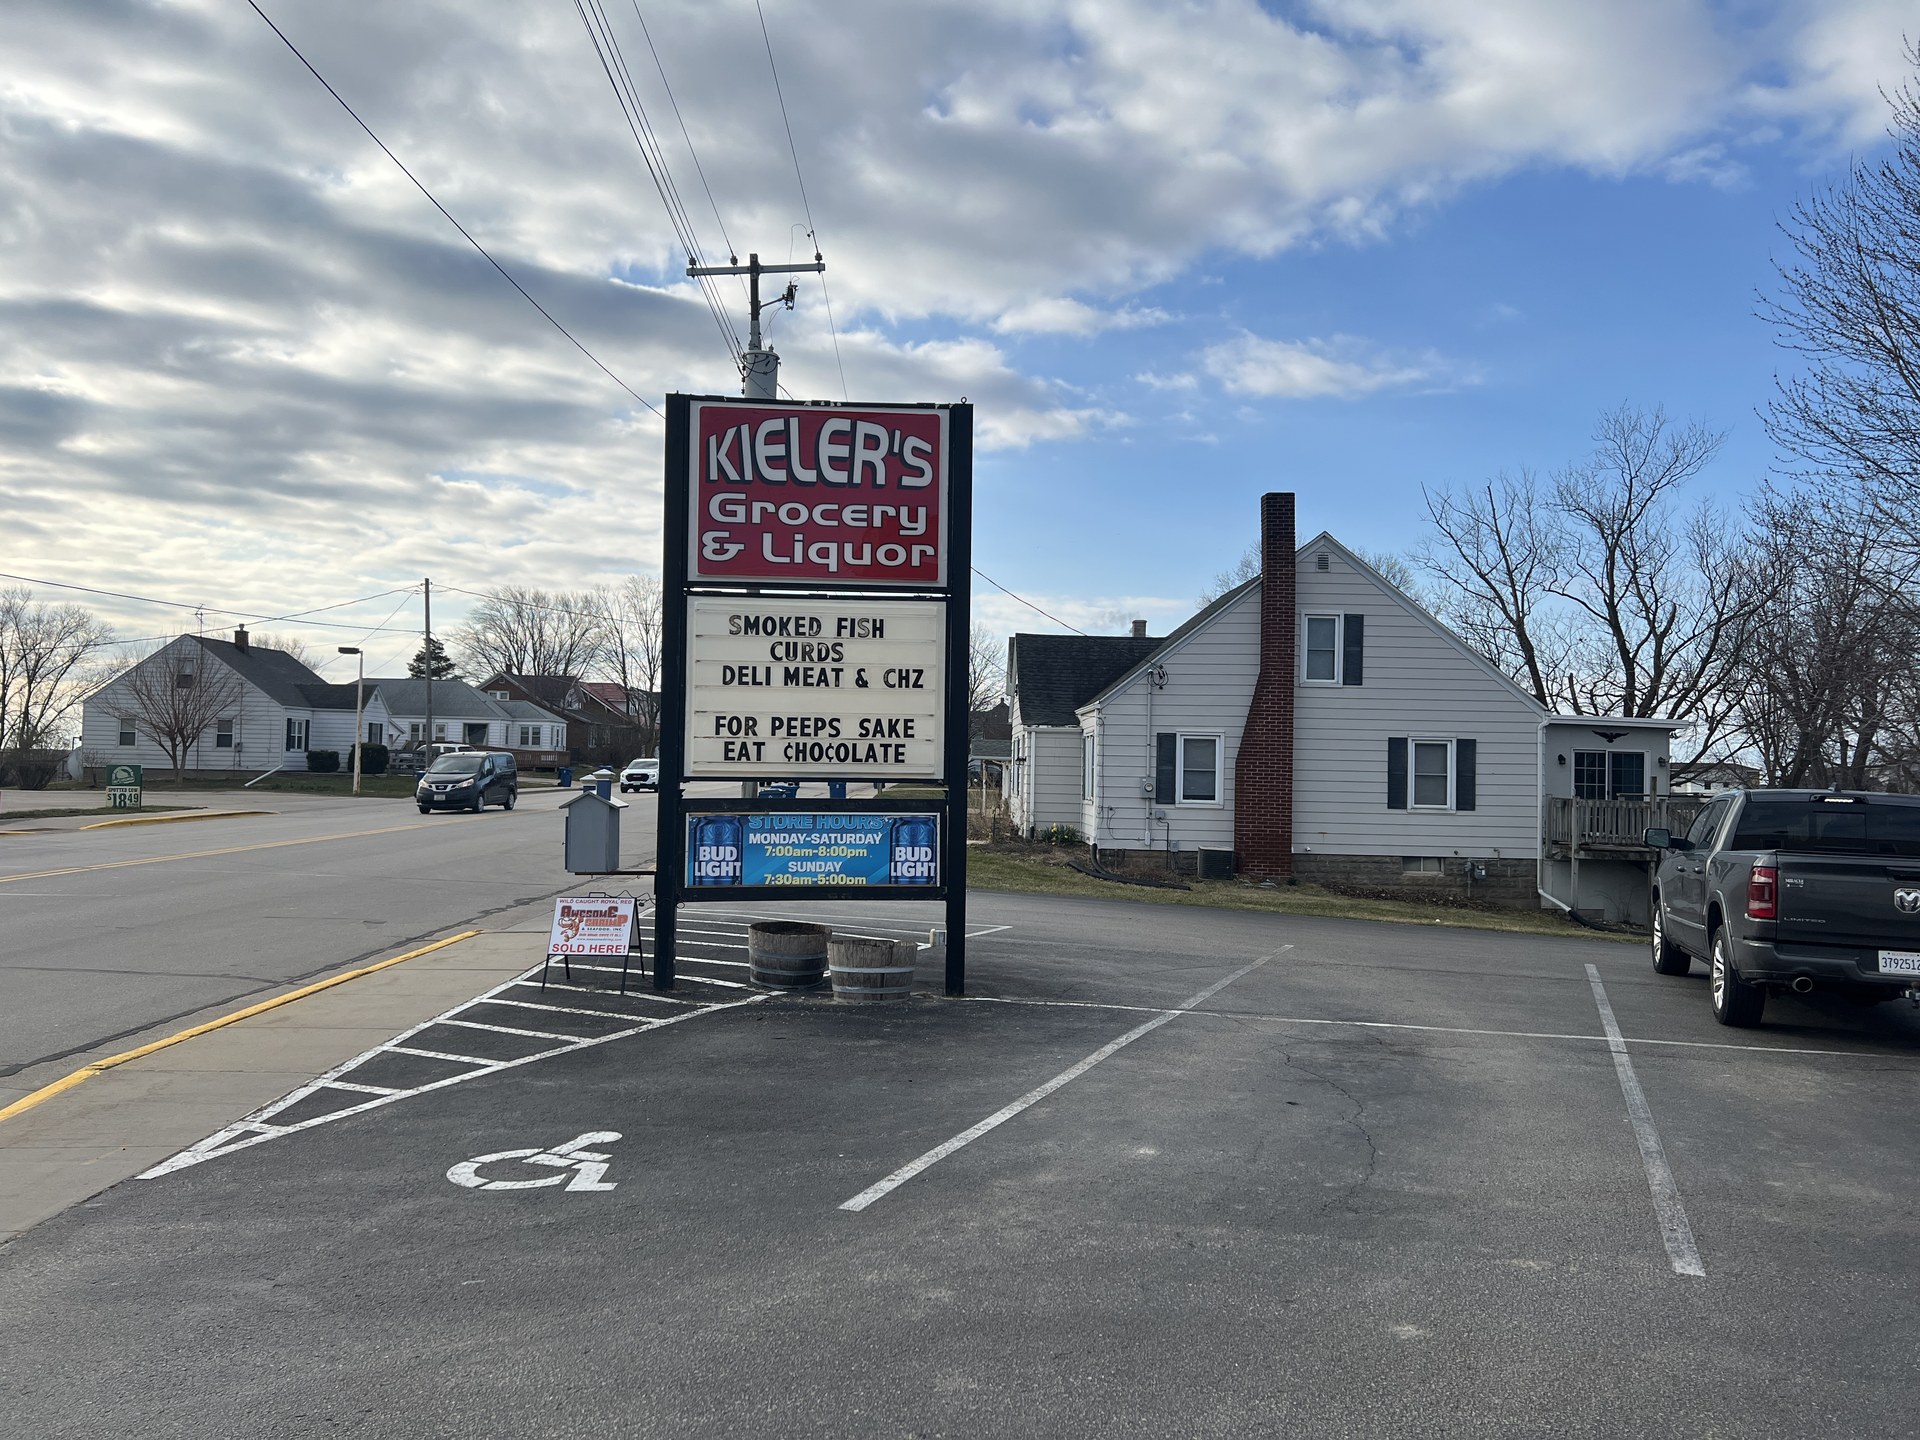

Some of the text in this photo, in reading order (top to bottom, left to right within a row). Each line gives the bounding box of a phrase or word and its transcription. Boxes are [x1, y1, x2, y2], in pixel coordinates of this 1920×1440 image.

[706, 416, 934, 489] KIELER'S
[708, 491, 928, 536] Grocery
[701, 530, 935, 573] & Liquor
[728, 614, 885, 639] SMOKED FISH
[769, 641, 845, 663] CURDS
[722, 665, 924, 689] DELI MEAT & CHZ
[714, 716, 915, 739] FOR PEEPS SAKE
[723, 741, 766, 762] EAT
[747, 815, 883, 830] STORE HOURS
[748, 833, 883, 845] MONDAY-SATURDAY
[699, 846, 738, 861] BUD
[764, 846, 868, 859] 7:00am-8:00pm
[895, 846, 932, 862] BUD
[694, 861, 742, 877] LIGHT
[788, 861, 843, 873] SUNDAY
[890, 862, 936, 877] LIGHT
[763, 873, 867, 886] 7:30am-5:00pm
[552, 943, 626, 954] SOLD HERE!
